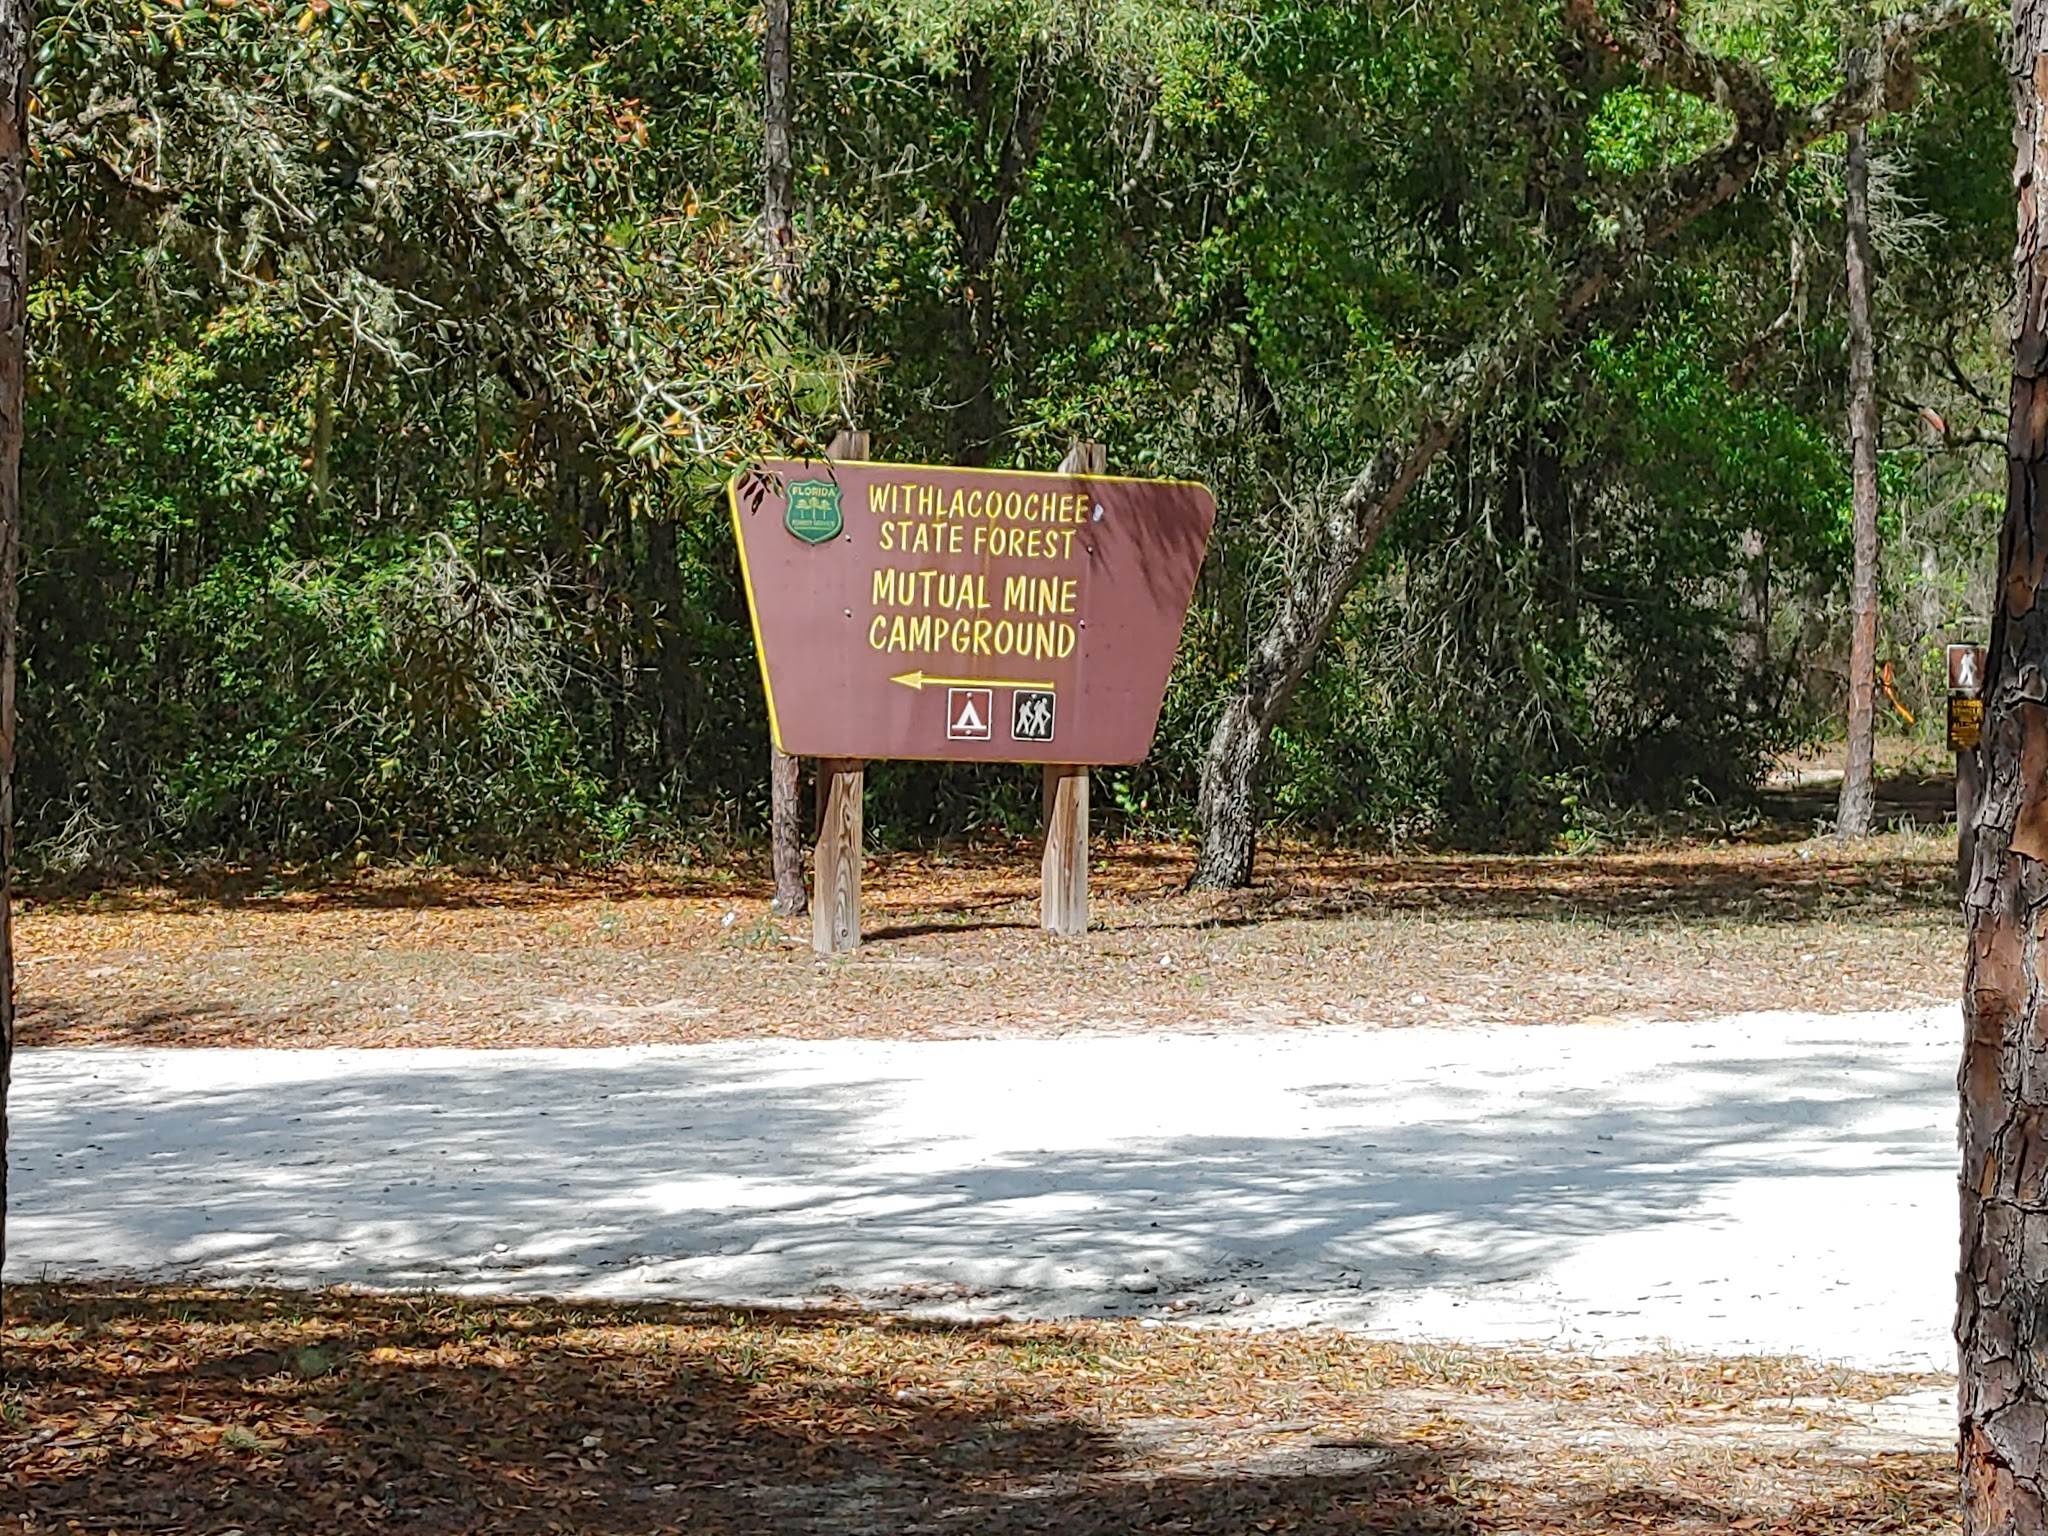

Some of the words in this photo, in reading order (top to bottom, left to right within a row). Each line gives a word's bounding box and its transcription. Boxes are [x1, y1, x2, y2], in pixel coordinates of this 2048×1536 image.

[792, 486, 836, 497] FLORIDA
[869, 483, 1089, 524] WITHLACOOCHEE
[879, 521, 963, 554] STATE
[974, 526, 1076, 559] FOREST
[873, 568, 991, 609] MUTUAL
[1004, 575, 1077, 615] MINE
[869, 615, 1076, 660] CAMPGROUND
